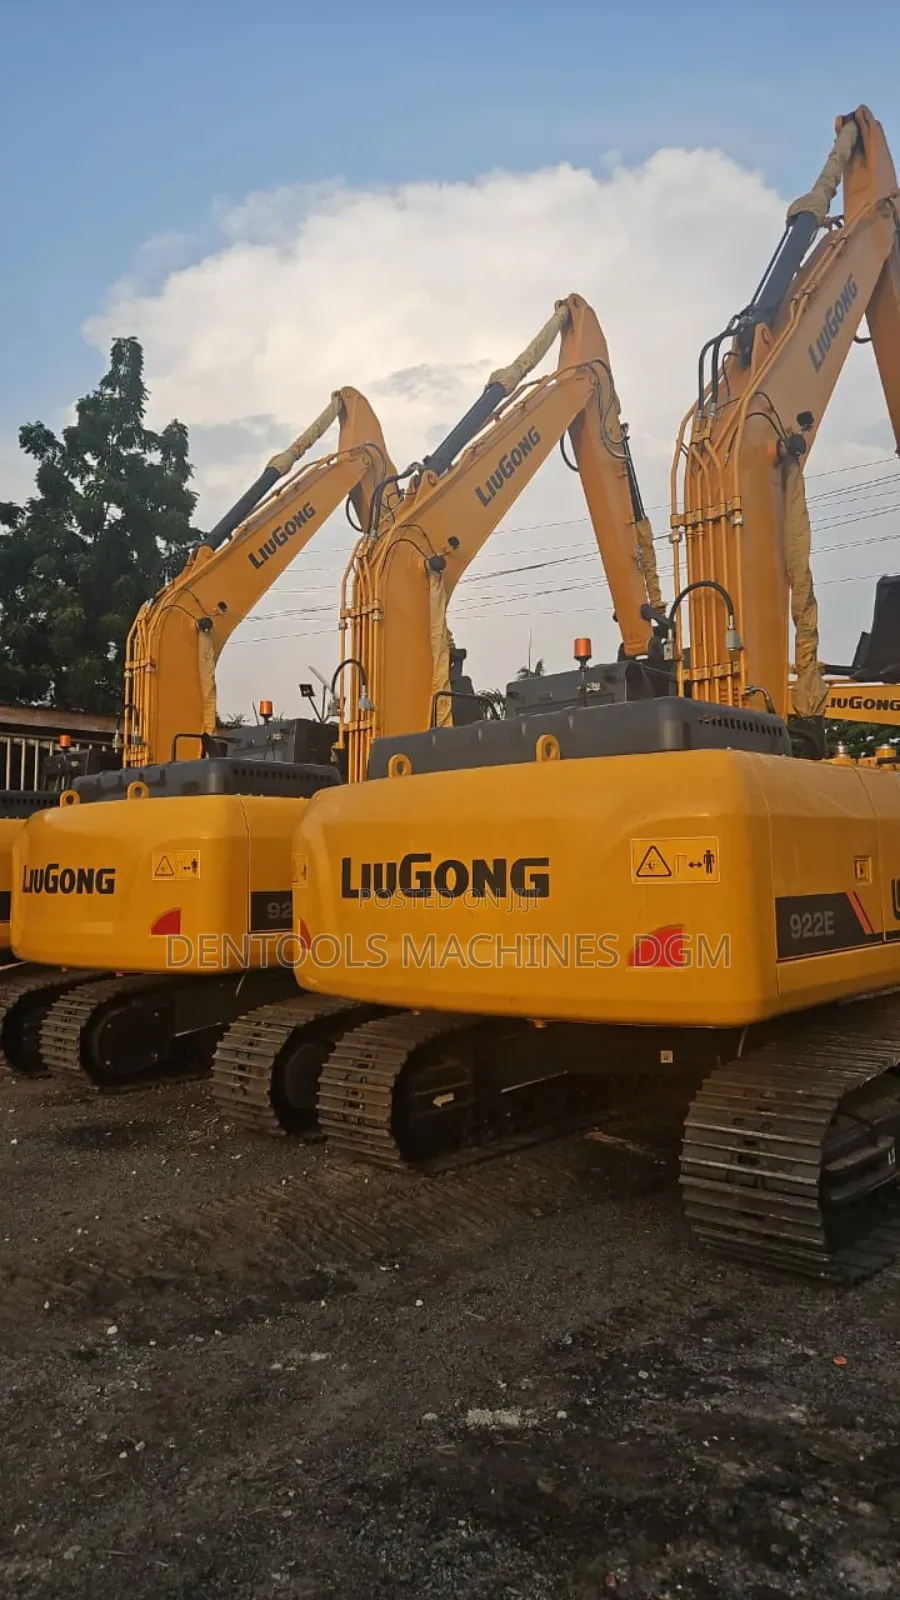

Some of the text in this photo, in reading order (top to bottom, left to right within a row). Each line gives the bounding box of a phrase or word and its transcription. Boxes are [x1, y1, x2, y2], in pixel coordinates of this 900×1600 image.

[825, 695, 900, 711] IUGONG
[267, 902, 292, 919] 92
[789, 911, 835, 939] 922E
